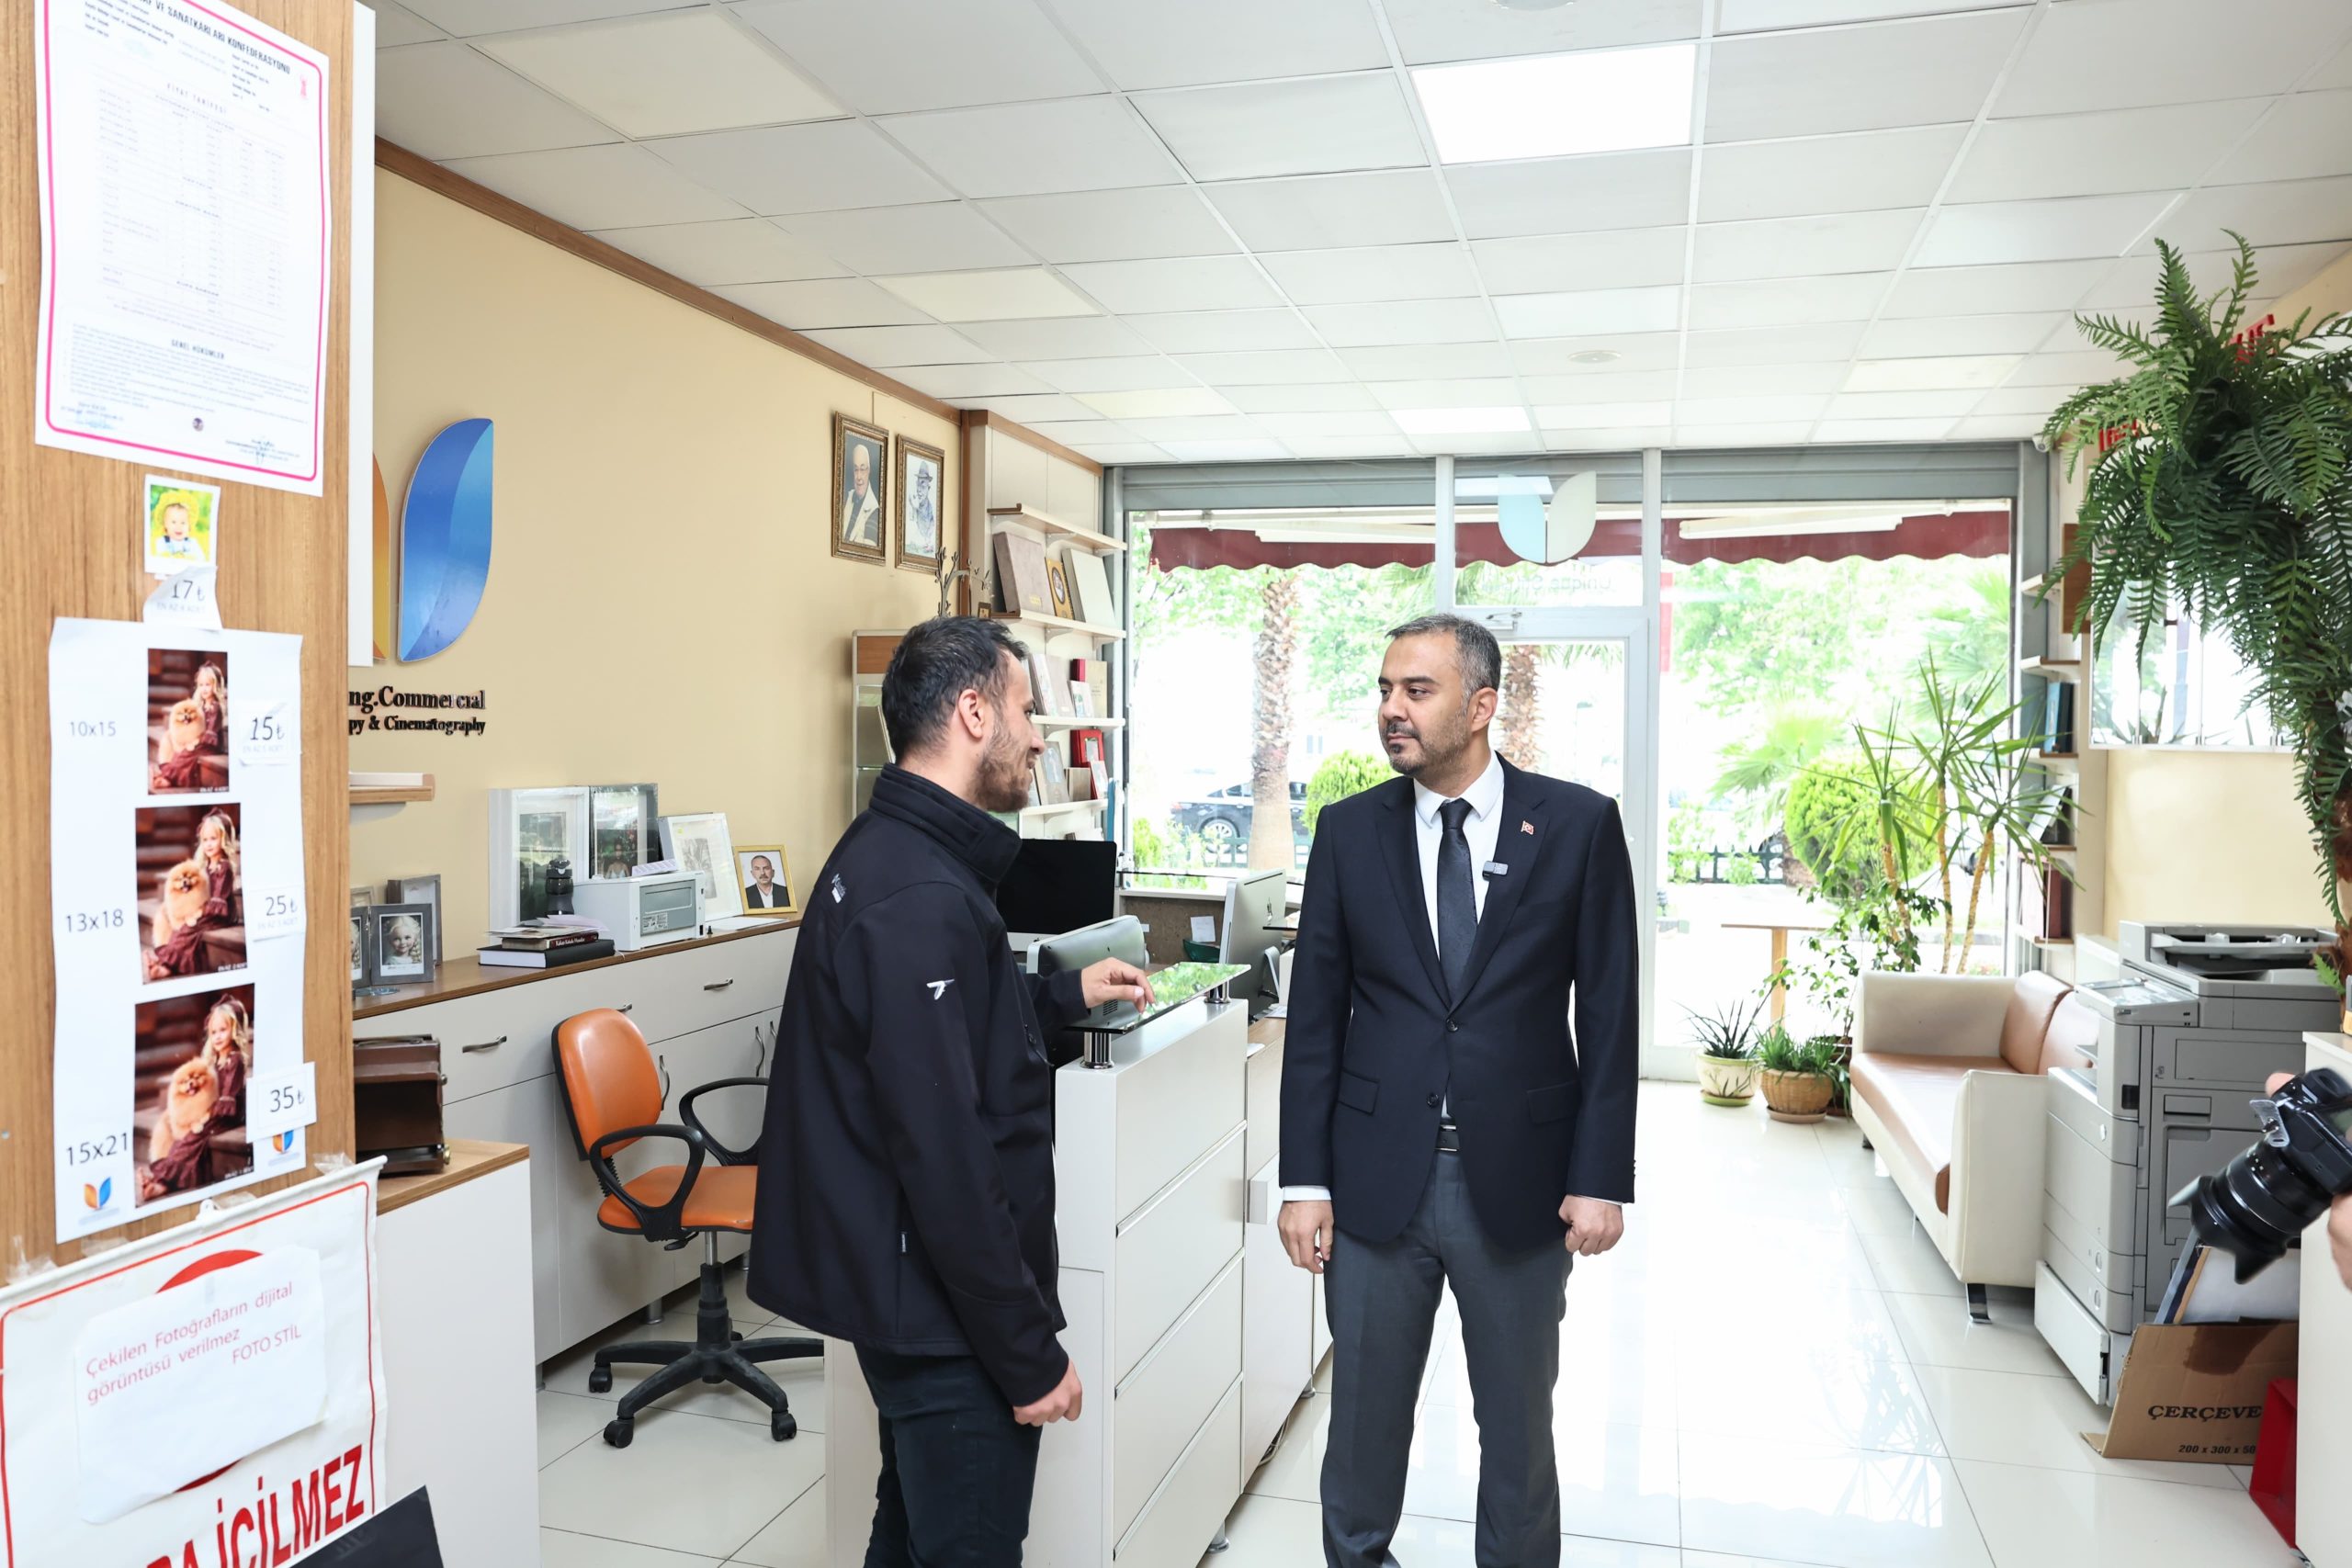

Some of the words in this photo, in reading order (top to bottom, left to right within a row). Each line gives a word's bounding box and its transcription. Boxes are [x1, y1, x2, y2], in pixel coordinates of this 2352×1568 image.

[70, 721, 117, 738] 10x15
[368, 715, 380, 730] &
[384, 715, 486, 737] Cinematography
[66, 908, 124, 932] 13x18
[66, 1133, 128, 1167] 15x21
[85, 1342, 147, 1379] Çekilen
[154, 1302, 248, 1349] Fotoğrafların
[254, 1281, 293, 1310] dijital
[232, 1337, 272, 1365] FOTO
[275, 1325, 302, 1348] STİL
[87, 1355, 172, 1407] görüntüsü
[178, 1329, 240, 1363] verilmez
[2147, 1405, 2263, 1423] ÇERÇEVE
[2178, 1445, 2199, 1454] 200
[2211, 1446, 2232, 1455] 300
